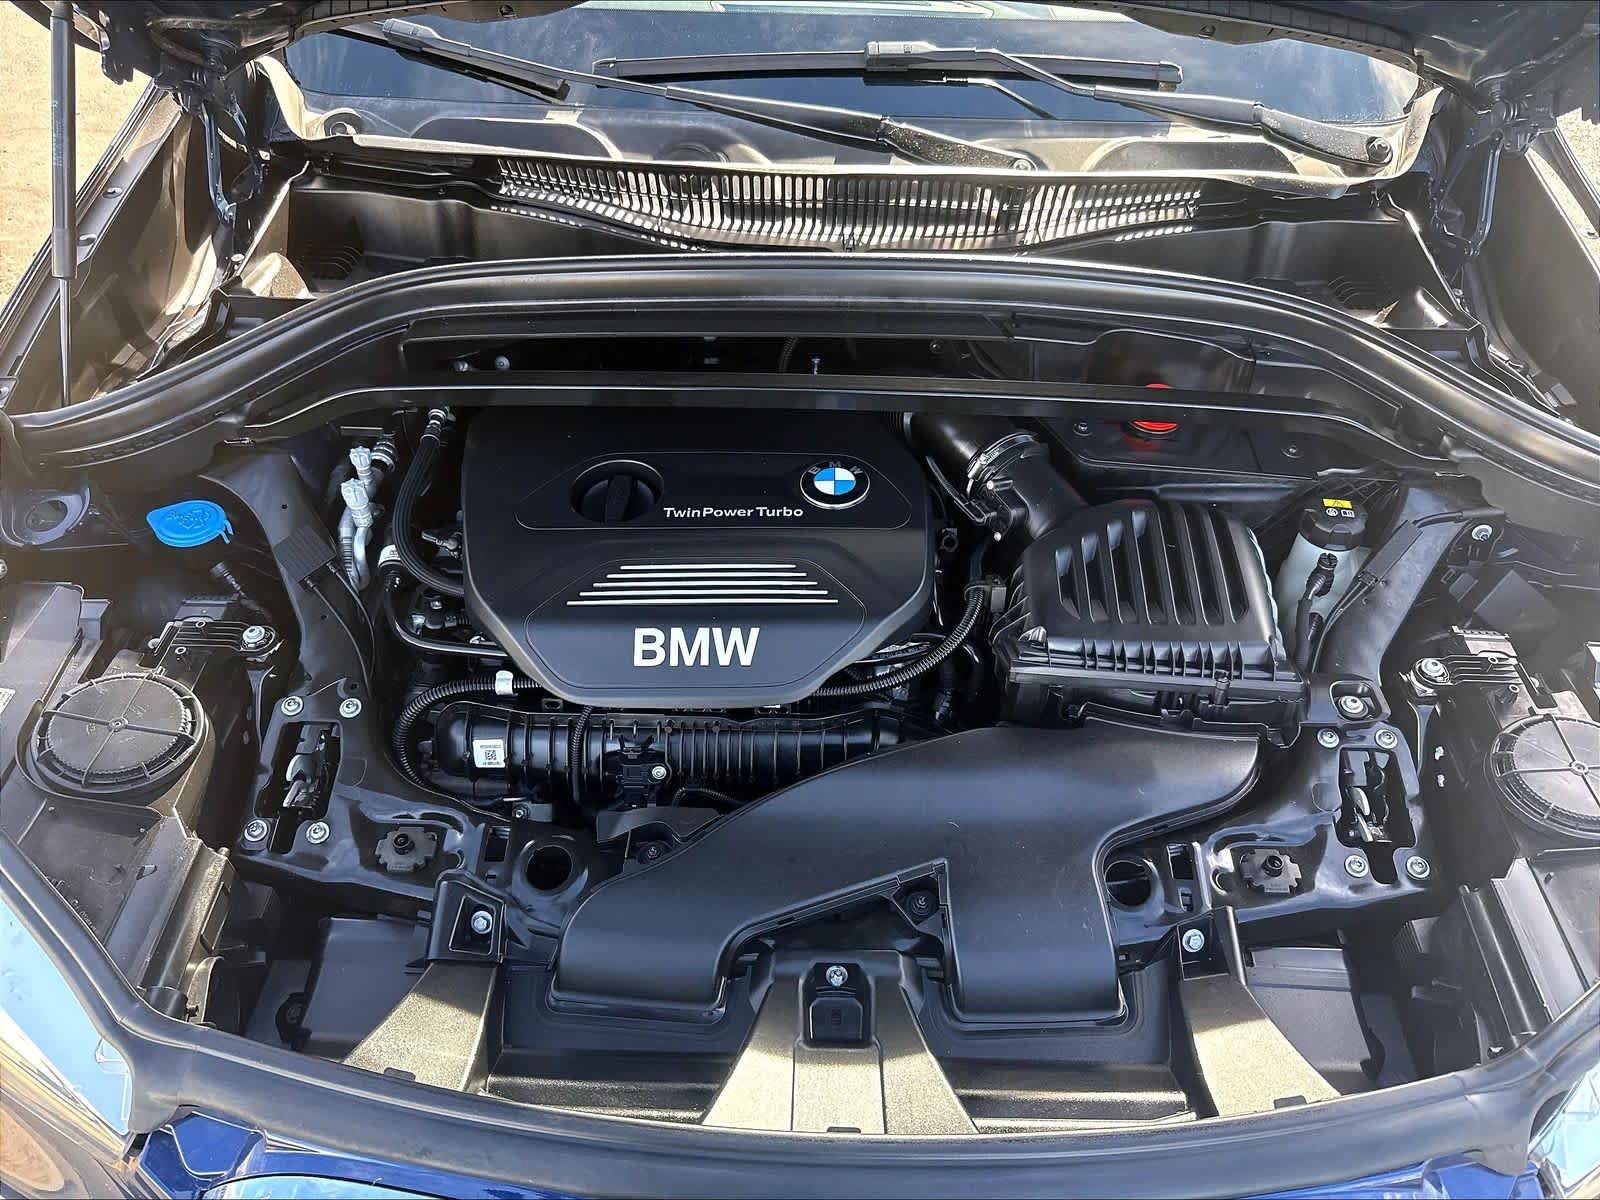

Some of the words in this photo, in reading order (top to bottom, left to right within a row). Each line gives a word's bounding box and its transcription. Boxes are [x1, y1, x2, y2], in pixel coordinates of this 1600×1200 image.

[807, 461, 864, 474] BMW
[755, 506, 804, 517] Turbo
[633, 627, 761, 667] BMW
